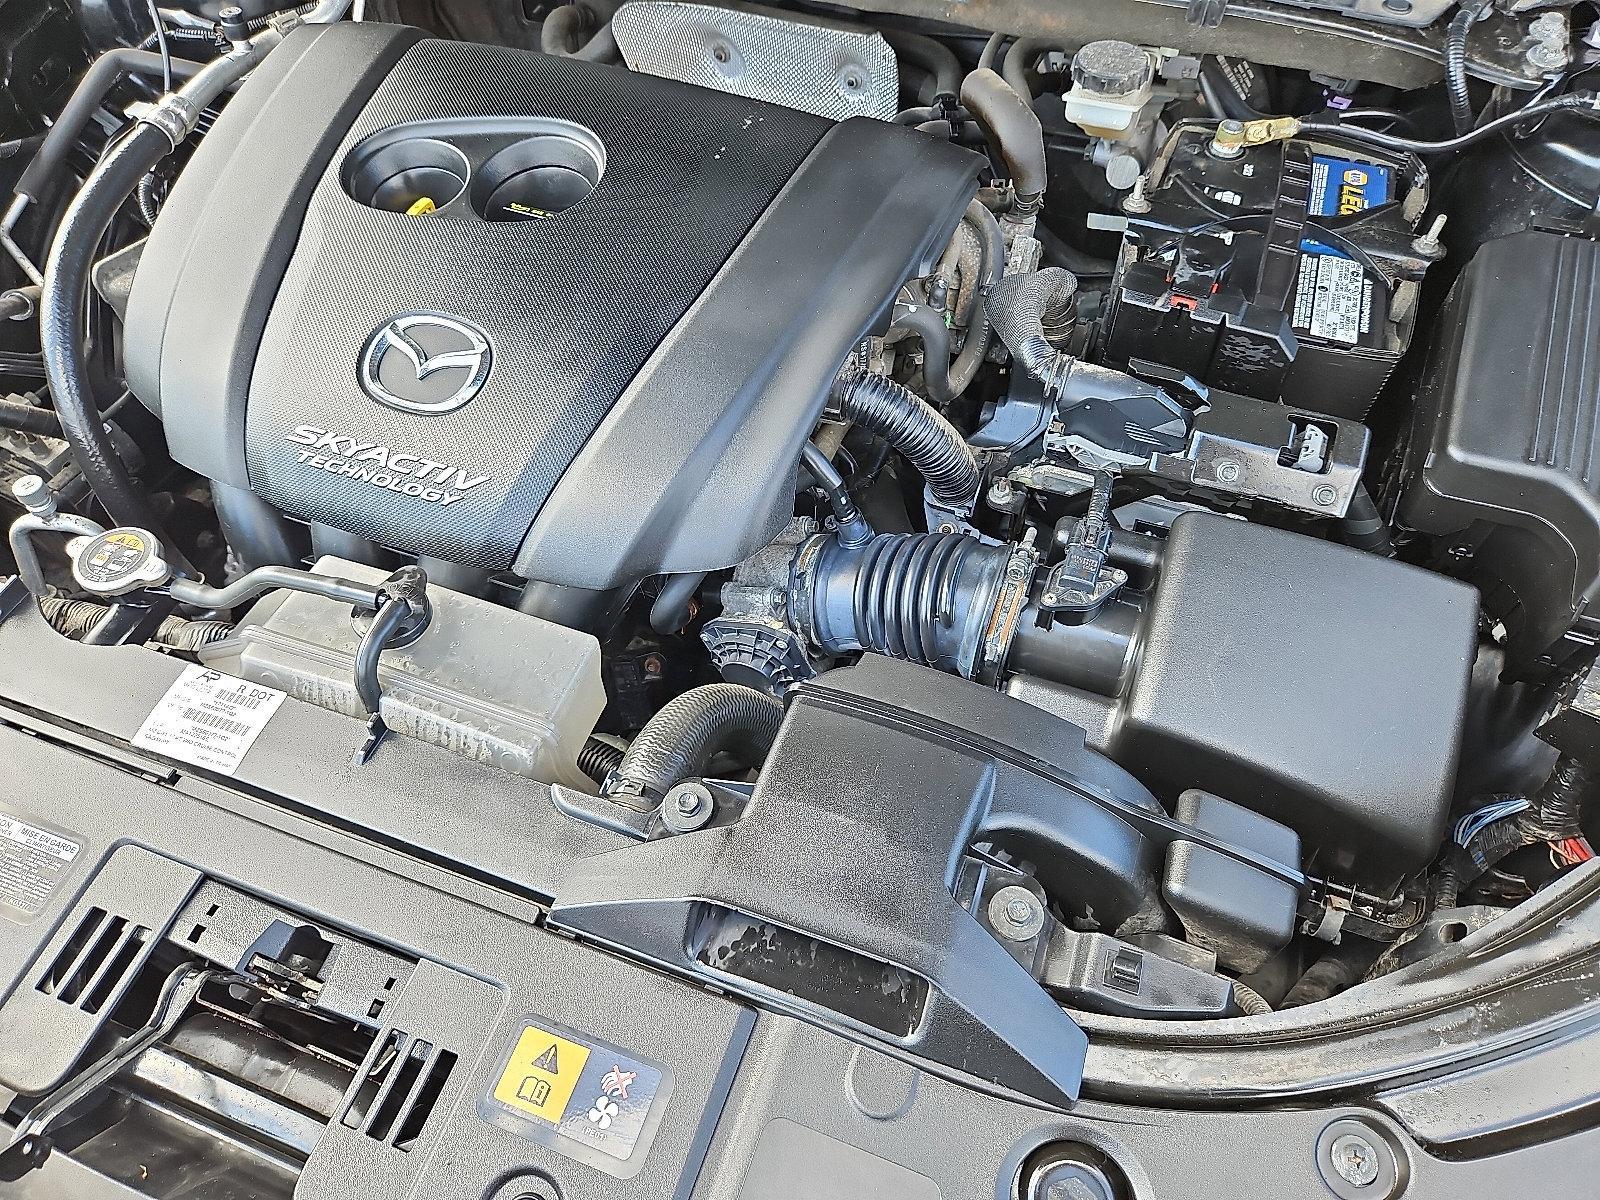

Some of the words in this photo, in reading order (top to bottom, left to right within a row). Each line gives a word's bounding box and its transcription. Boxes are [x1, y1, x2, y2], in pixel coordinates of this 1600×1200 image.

[286, 424, 491, 490] SKYACTIV
[298, 451, 464, 506] TECHNOLOGY
[249, 688, 276, 701] DOT
[20, 827, 40, 839] MISE
[50, 838, 77, 853] GARDE
